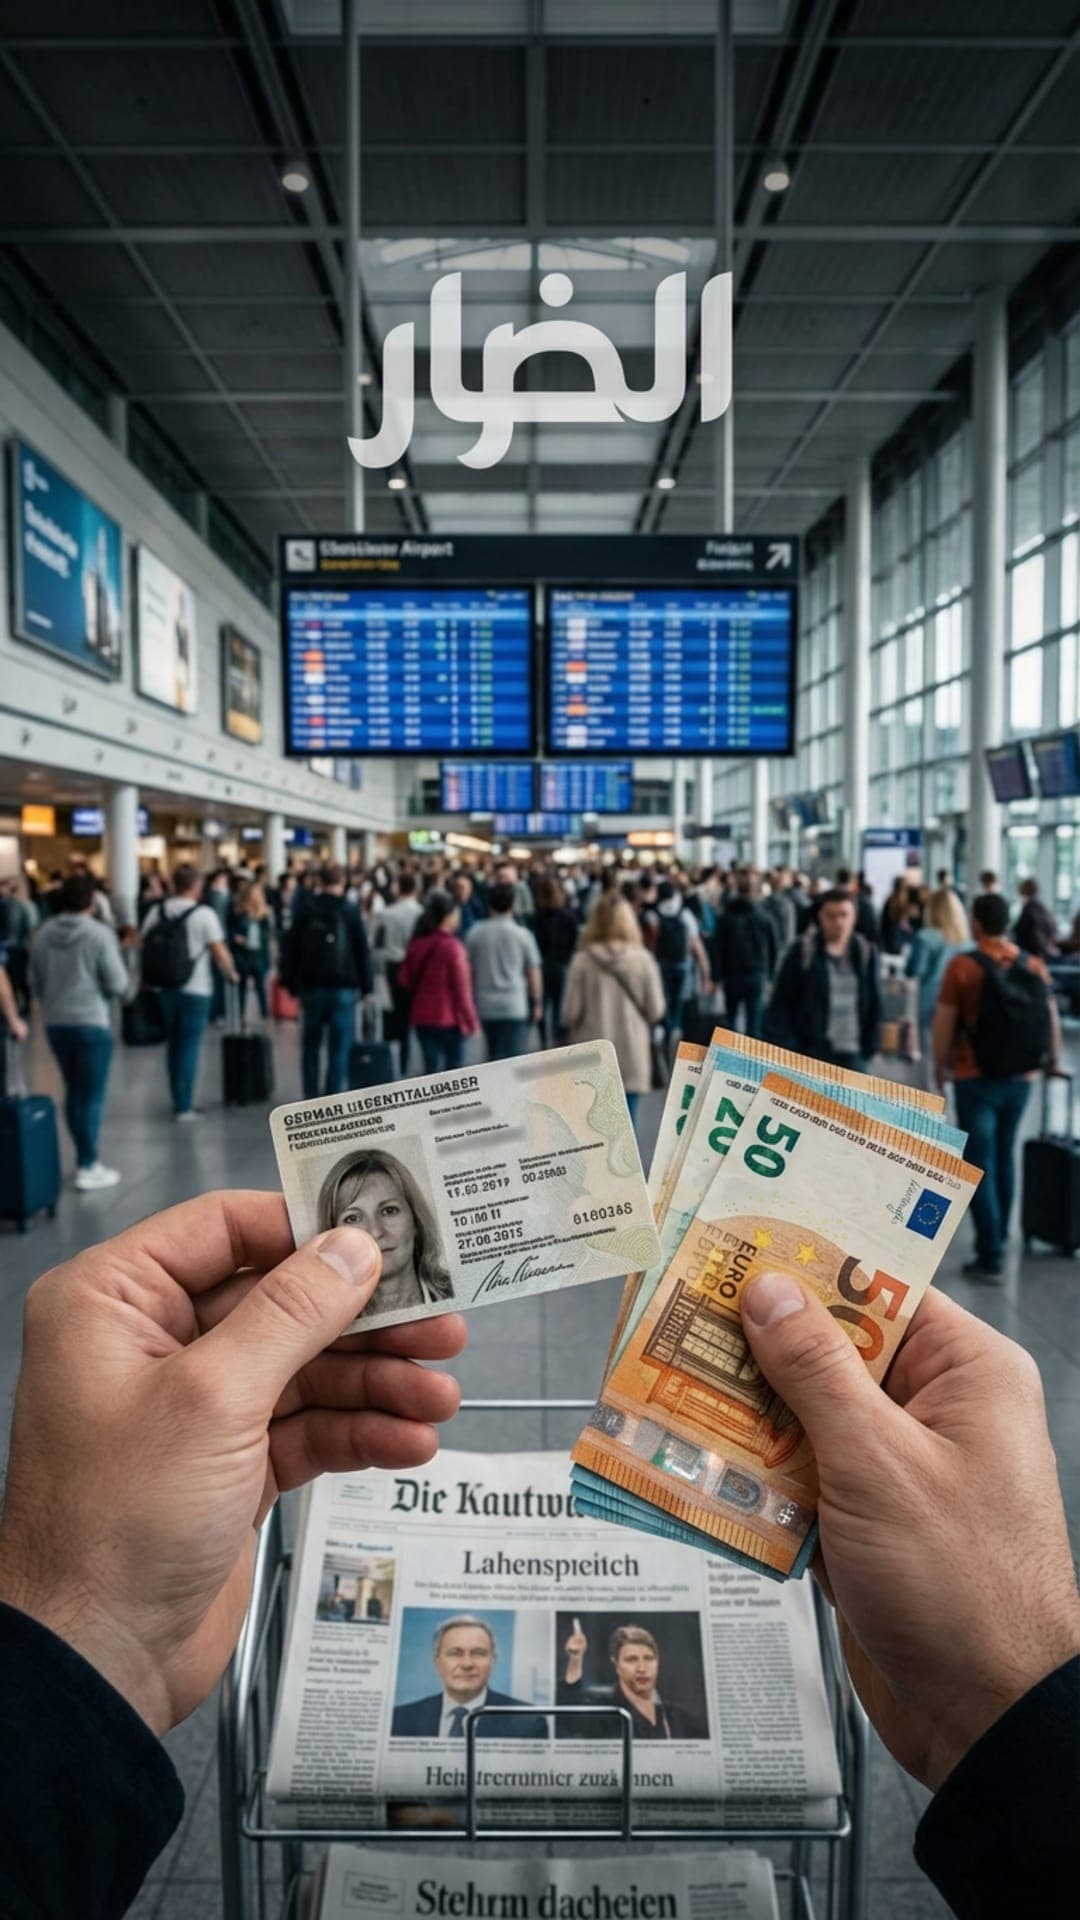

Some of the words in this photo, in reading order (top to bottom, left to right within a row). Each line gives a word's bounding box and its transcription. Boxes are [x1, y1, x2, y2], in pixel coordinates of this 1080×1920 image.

[743, 1114, 801, 1178] 50
[719, 1240, 758, 1300] EURO
[827, 1255, 911, 1362] 50
[390, 1478, 447, 1513] Die
